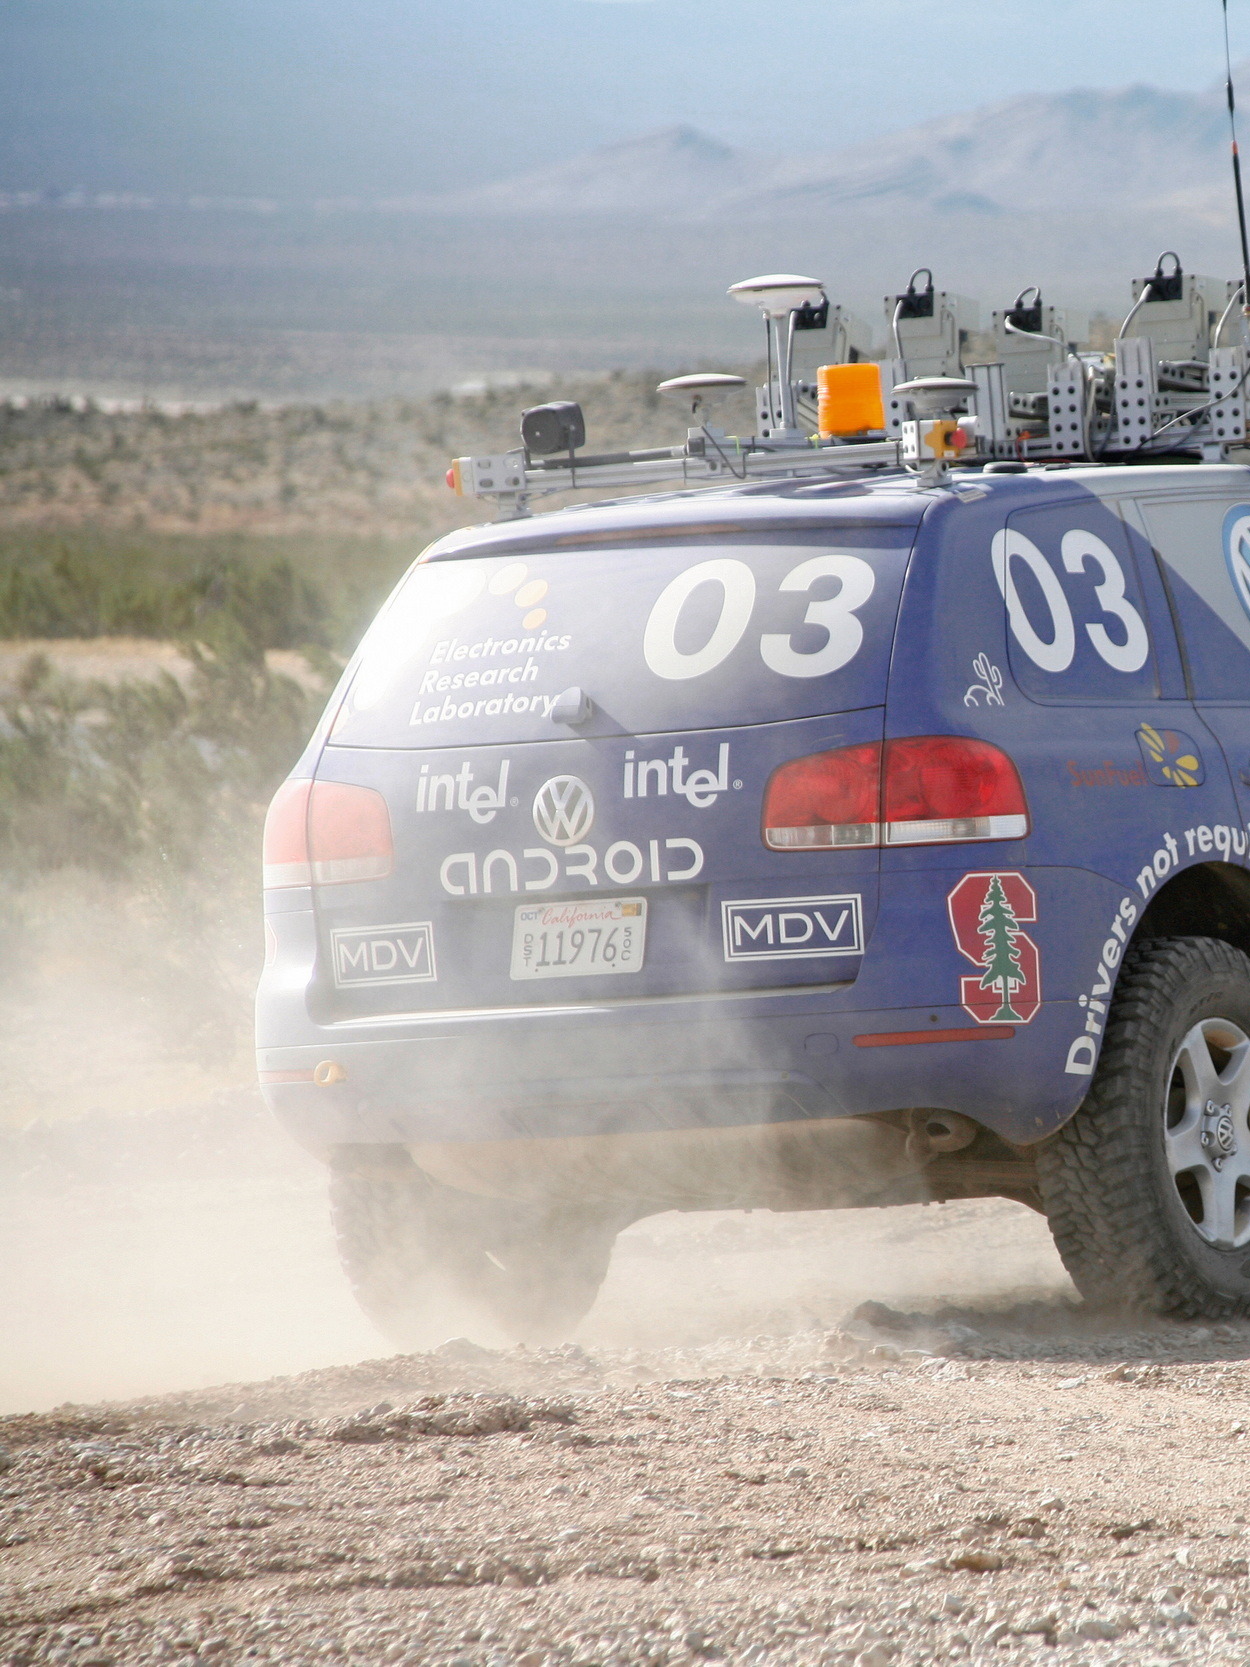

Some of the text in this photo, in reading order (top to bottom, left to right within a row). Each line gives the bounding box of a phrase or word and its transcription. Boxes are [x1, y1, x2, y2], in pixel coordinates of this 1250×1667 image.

[643, 554, 876, 681] 03
[991, 529, 1150, 673] 03
[428, 629, 573, 666] Electronics
[417, 656, 539, 695] Research
[408, 692, 563, 726] Laboratory
[415, 759, 510, 825] intel
[623, 742, 730, 808] intel
[440, 837, 705, 895] ANDROID
[520, 911, 539, 921] OCT
[541, 906, 624, 929] California
[733, 909, 850, 946] MDV
[339, 937, 424, 974] MDV
[535, 926, 619, 967] 11976
[1064, 896, 1138, 1076] Drivers
[1135, 831, 1180, 899] not
